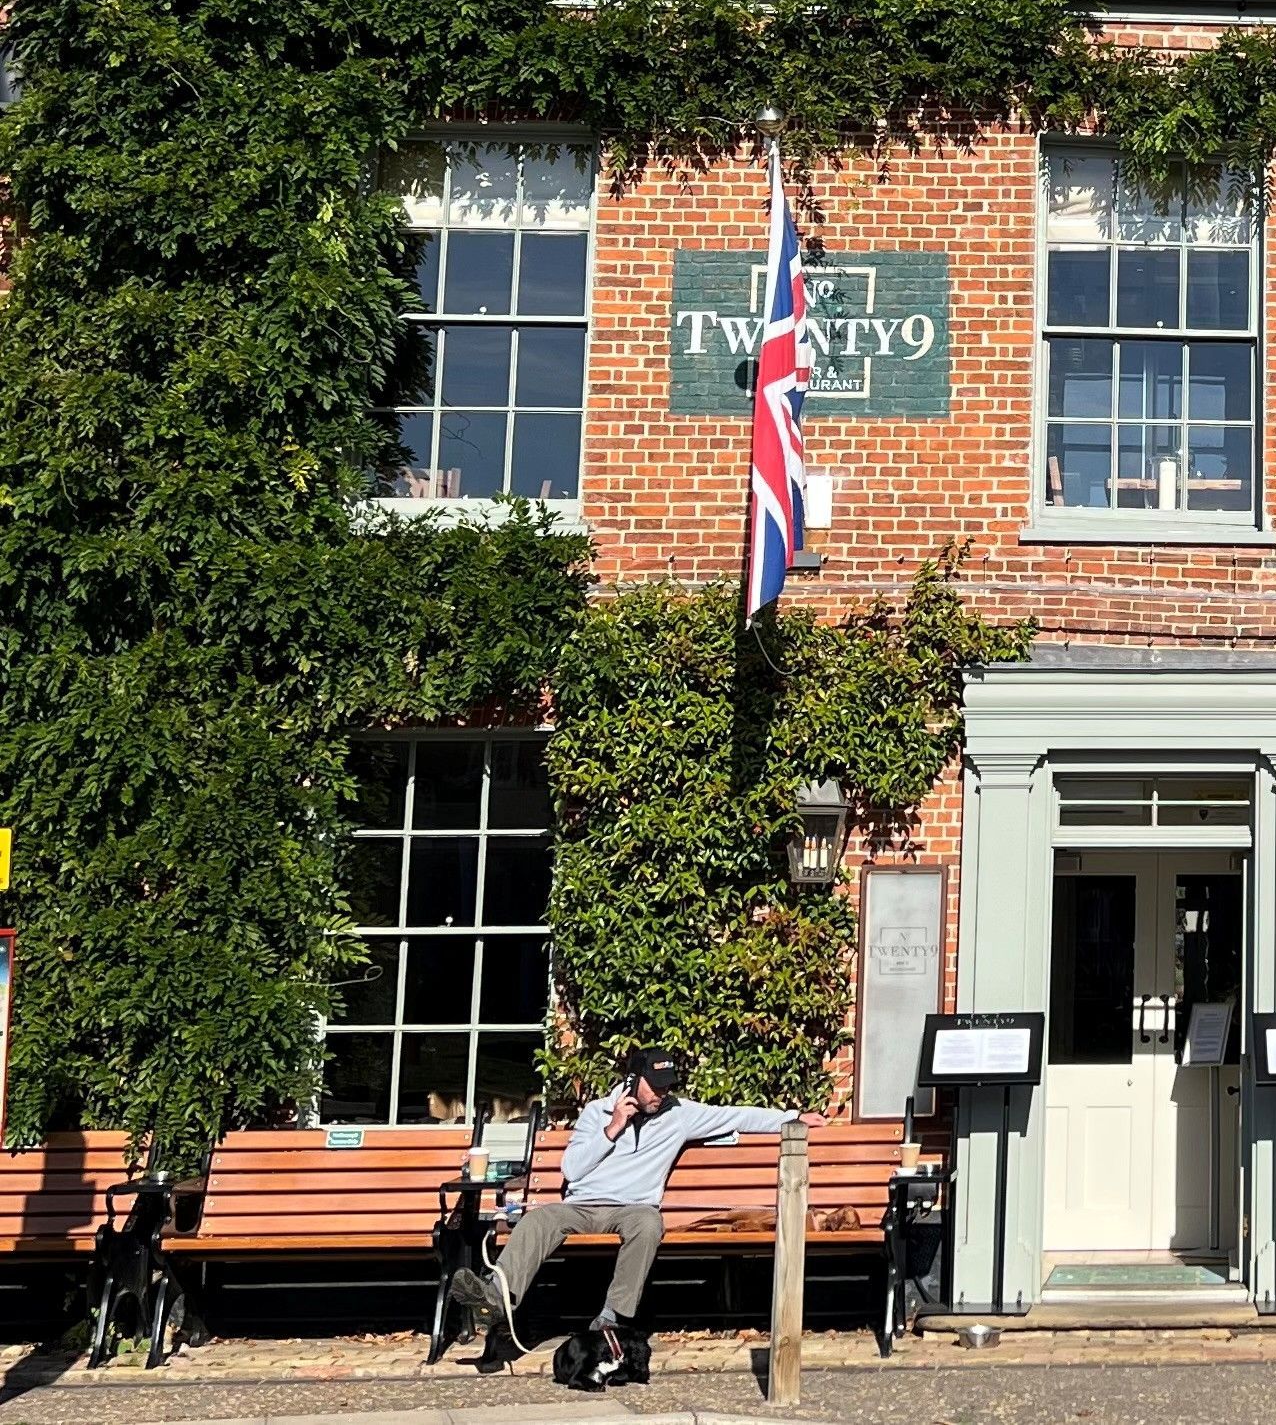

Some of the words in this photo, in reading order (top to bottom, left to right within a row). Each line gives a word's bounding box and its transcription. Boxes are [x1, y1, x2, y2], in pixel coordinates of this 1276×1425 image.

[677, 311, 935, 361] TWNTY9
[827, 366, 838, 378] &
[810, 379, 863, 391] URANT
[868, 943, 938, 958] TWENTY9
